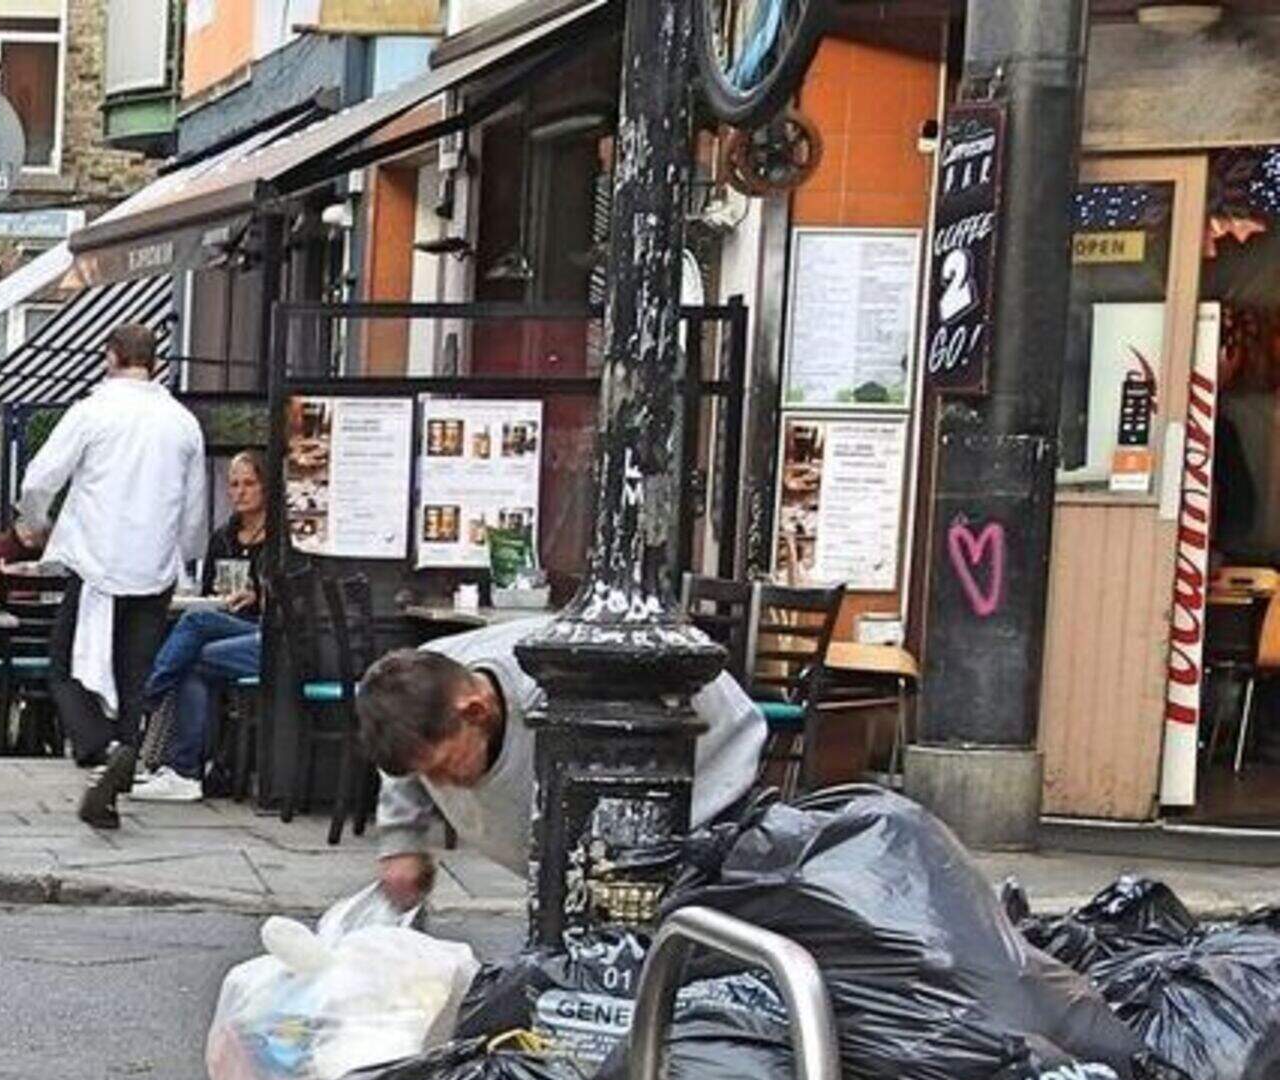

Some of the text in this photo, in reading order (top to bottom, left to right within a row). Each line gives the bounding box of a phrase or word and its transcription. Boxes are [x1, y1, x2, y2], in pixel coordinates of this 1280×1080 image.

[935, 212, 994, 256] COFFEE
[1076, 239, 1125, 256] OPEN
[940, 248, 977, 323] 2
[929, 323, 984, 374] GO!
[604, 966, 632, 990] 01
